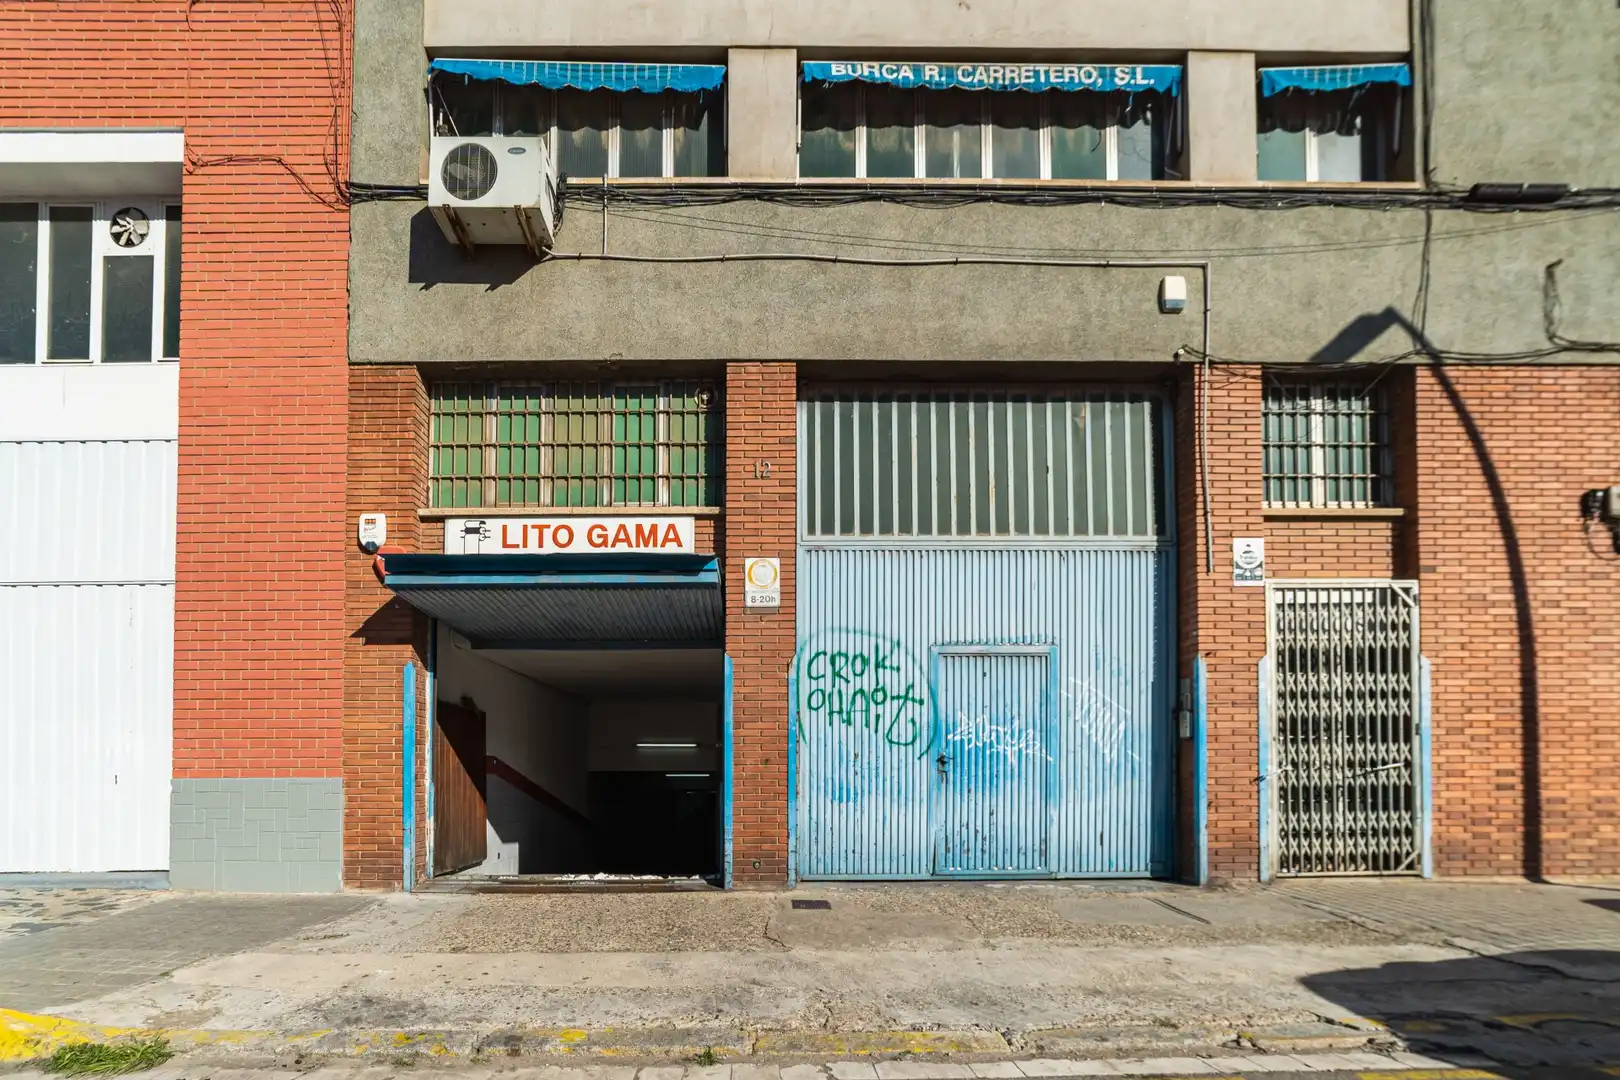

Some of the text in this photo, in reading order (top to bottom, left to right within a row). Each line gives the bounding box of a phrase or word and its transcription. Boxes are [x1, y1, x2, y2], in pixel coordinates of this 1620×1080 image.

[831, 63, 1155, 86] BURCA R. CARRETERO, S.L.
[752, 460, 771, 480] 12
[501, 523, 683, 549] LITO GAMA
